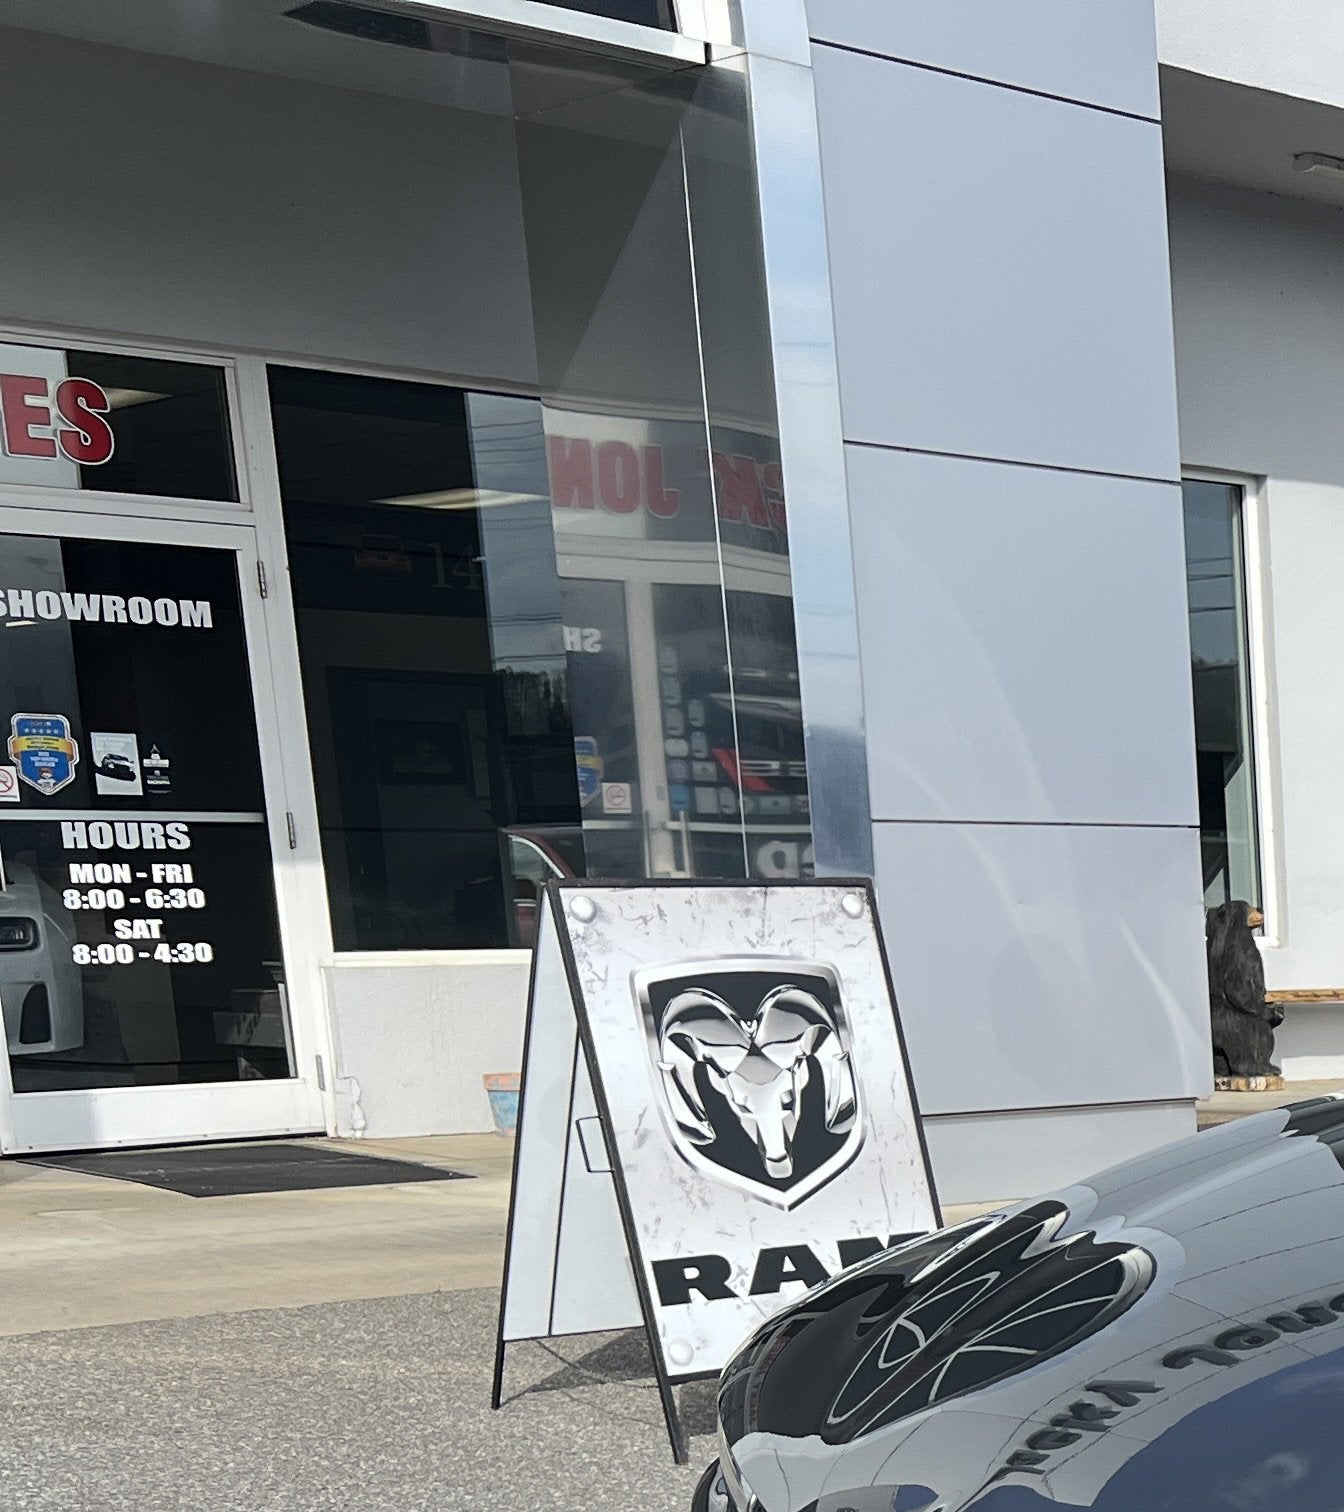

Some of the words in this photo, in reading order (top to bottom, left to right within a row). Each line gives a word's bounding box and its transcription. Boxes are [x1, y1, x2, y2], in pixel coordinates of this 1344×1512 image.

[0, 373, 115, 466] ES
[60, 821, 192, 851] HOURS
[68, 863, 132, 884] MON
[151, 863, 194, 884] FRI
[62, 888, 126, 910] 8:00
[144, 887, 206, 909] 6:30
[113, 918, 164, 940] SAT
[72, 943, 135, 965] 8:00
[153, 942, 214, 964] 4:30
